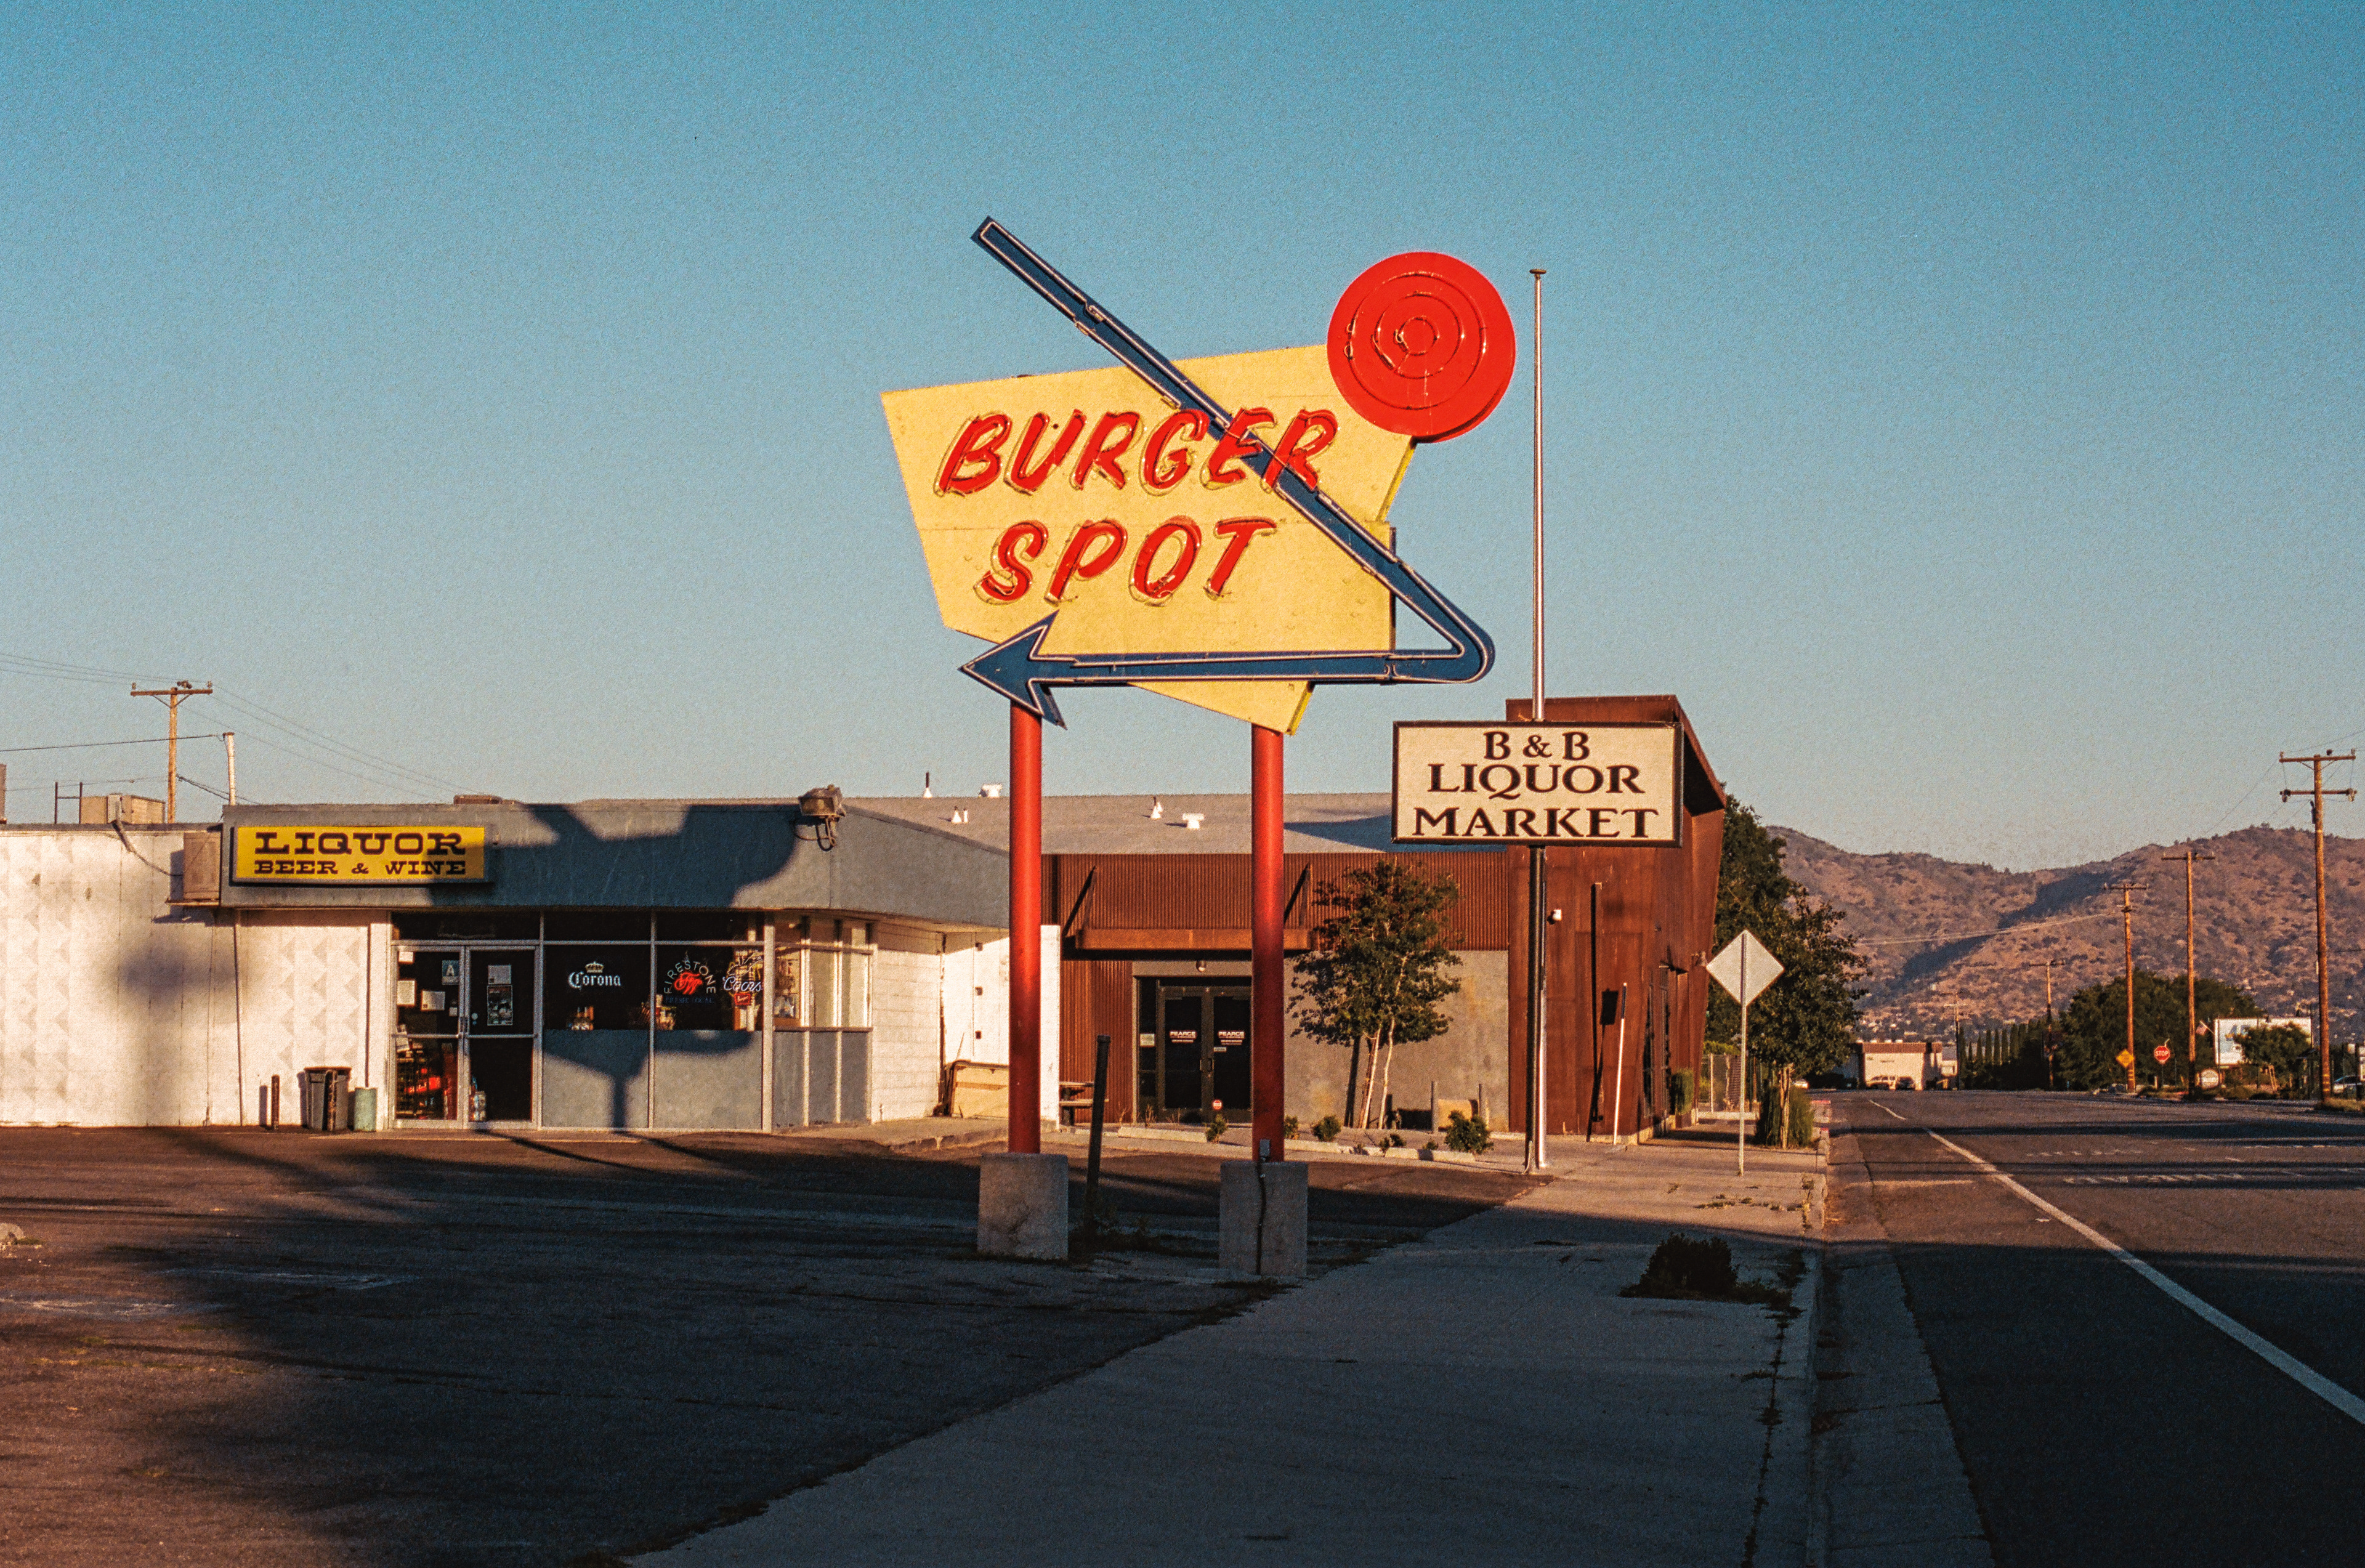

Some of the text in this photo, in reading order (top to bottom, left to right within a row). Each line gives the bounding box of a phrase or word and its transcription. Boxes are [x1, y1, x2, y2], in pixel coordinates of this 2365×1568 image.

[933, 406, 1340, 496] BURGER
[974, 515, 1278, 607] SPOT
[1427, 764, 1645, 800] LIQUOR
[1412, 807, 1659, 838] MARKET
[254, 832, 466, 855] LIQUOR
[254, 860, 466, 875] BEER & WINE
[445, 964, 455, 977] A
[568, 971, 621, 990] Corona
[664, 960, 716, 993] FIRESTONE
[723, 976, 763, 992] Coors
